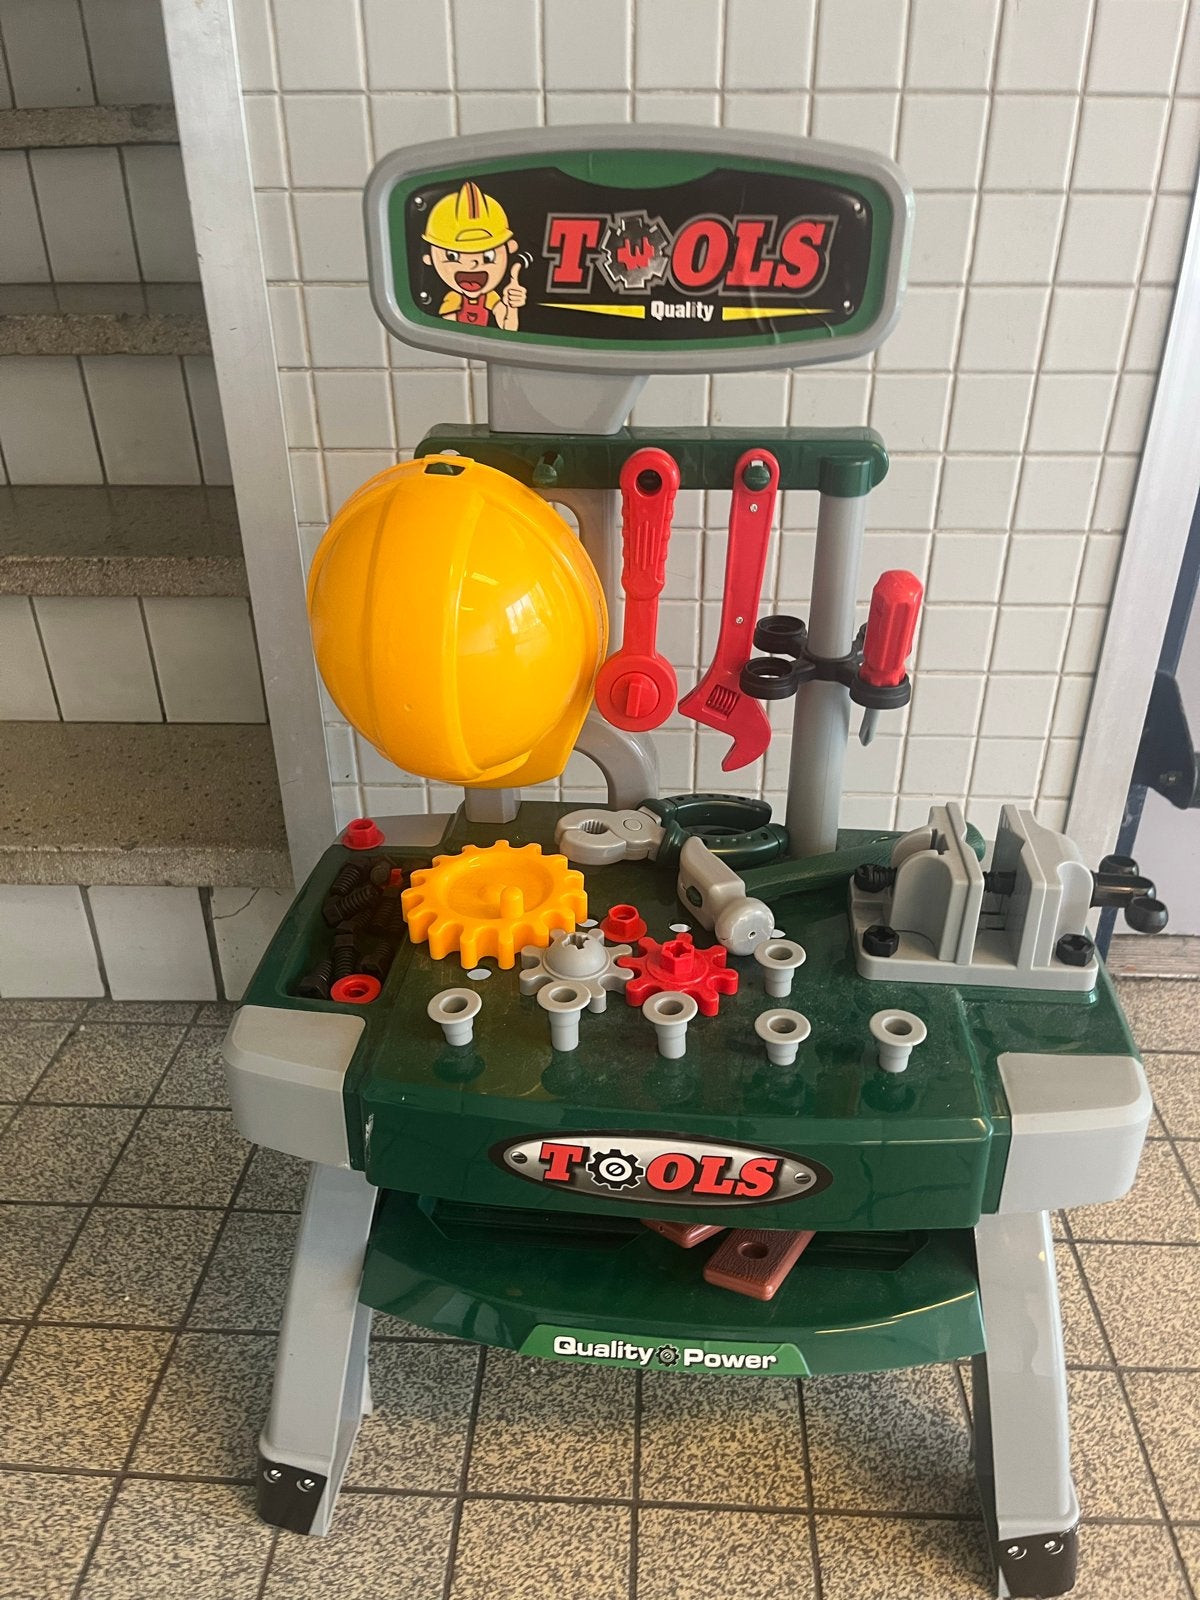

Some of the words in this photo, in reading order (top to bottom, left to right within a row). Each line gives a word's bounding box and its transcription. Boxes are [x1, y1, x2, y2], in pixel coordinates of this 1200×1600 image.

[546, 211, 829, 292] TOOLS
[650, 300, 715, 322] Quality
[539, 1142, 777, 1197] TOOLS
[553, 1335, 655, 1366] Quality
[683, 1348, 778, 1370] Power
